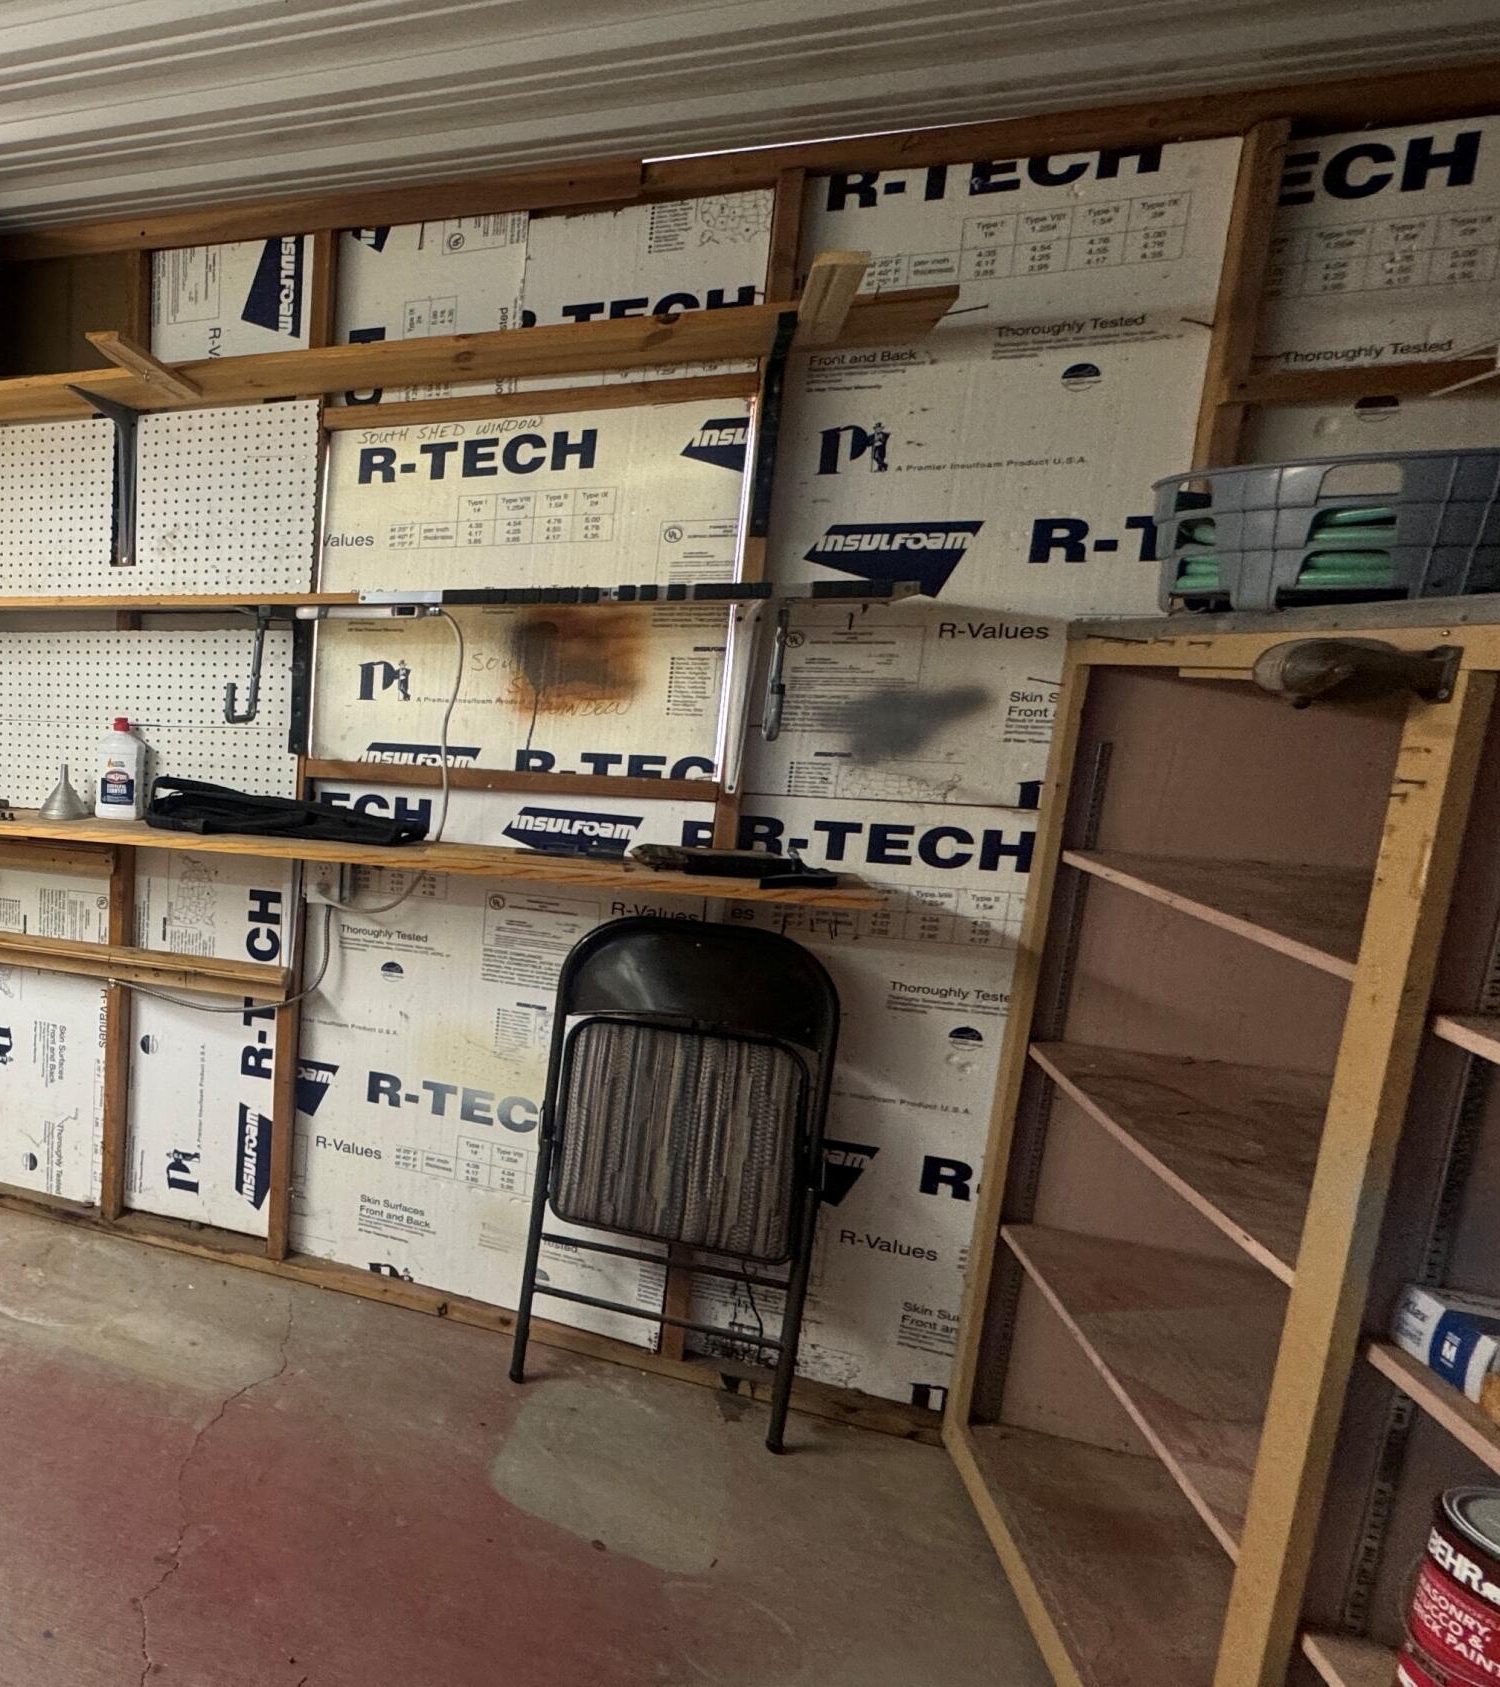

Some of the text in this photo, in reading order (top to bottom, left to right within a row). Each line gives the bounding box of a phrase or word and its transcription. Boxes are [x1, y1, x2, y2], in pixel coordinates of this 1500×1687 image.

[994, 314, 1146, 339] Thoroughly Tested
[809, 349, 918, 366] Front and Back
[1283, 339, 1453, 363] Thoroughly Tested
[417, 423, 466, 440] SHED
[358, 428, 598, 484] R-TECH
[938, 622, 1049, 640] R-Values
[1007, 707, 1048, 718] Front
[340, 924, 428, 943] Thoroughly Tested
[890, 981, 970, 1000] Thoroughly
[315, 1135, 382, 1160] R-Values
[360, 1194, 425, 1217] Skin Surfaces
[359, 1205, 384, 1219] Front
[386, 1210, 404, 1223] and
[406, 1215, 431, 1229] Back
[840, 1229, 939, 1262] R-Values
[901, 1315, 938, 1332] Front
[1428, 1526, 1484, 1592] BEHR
[1468, 1634, 1484, 1651] &
